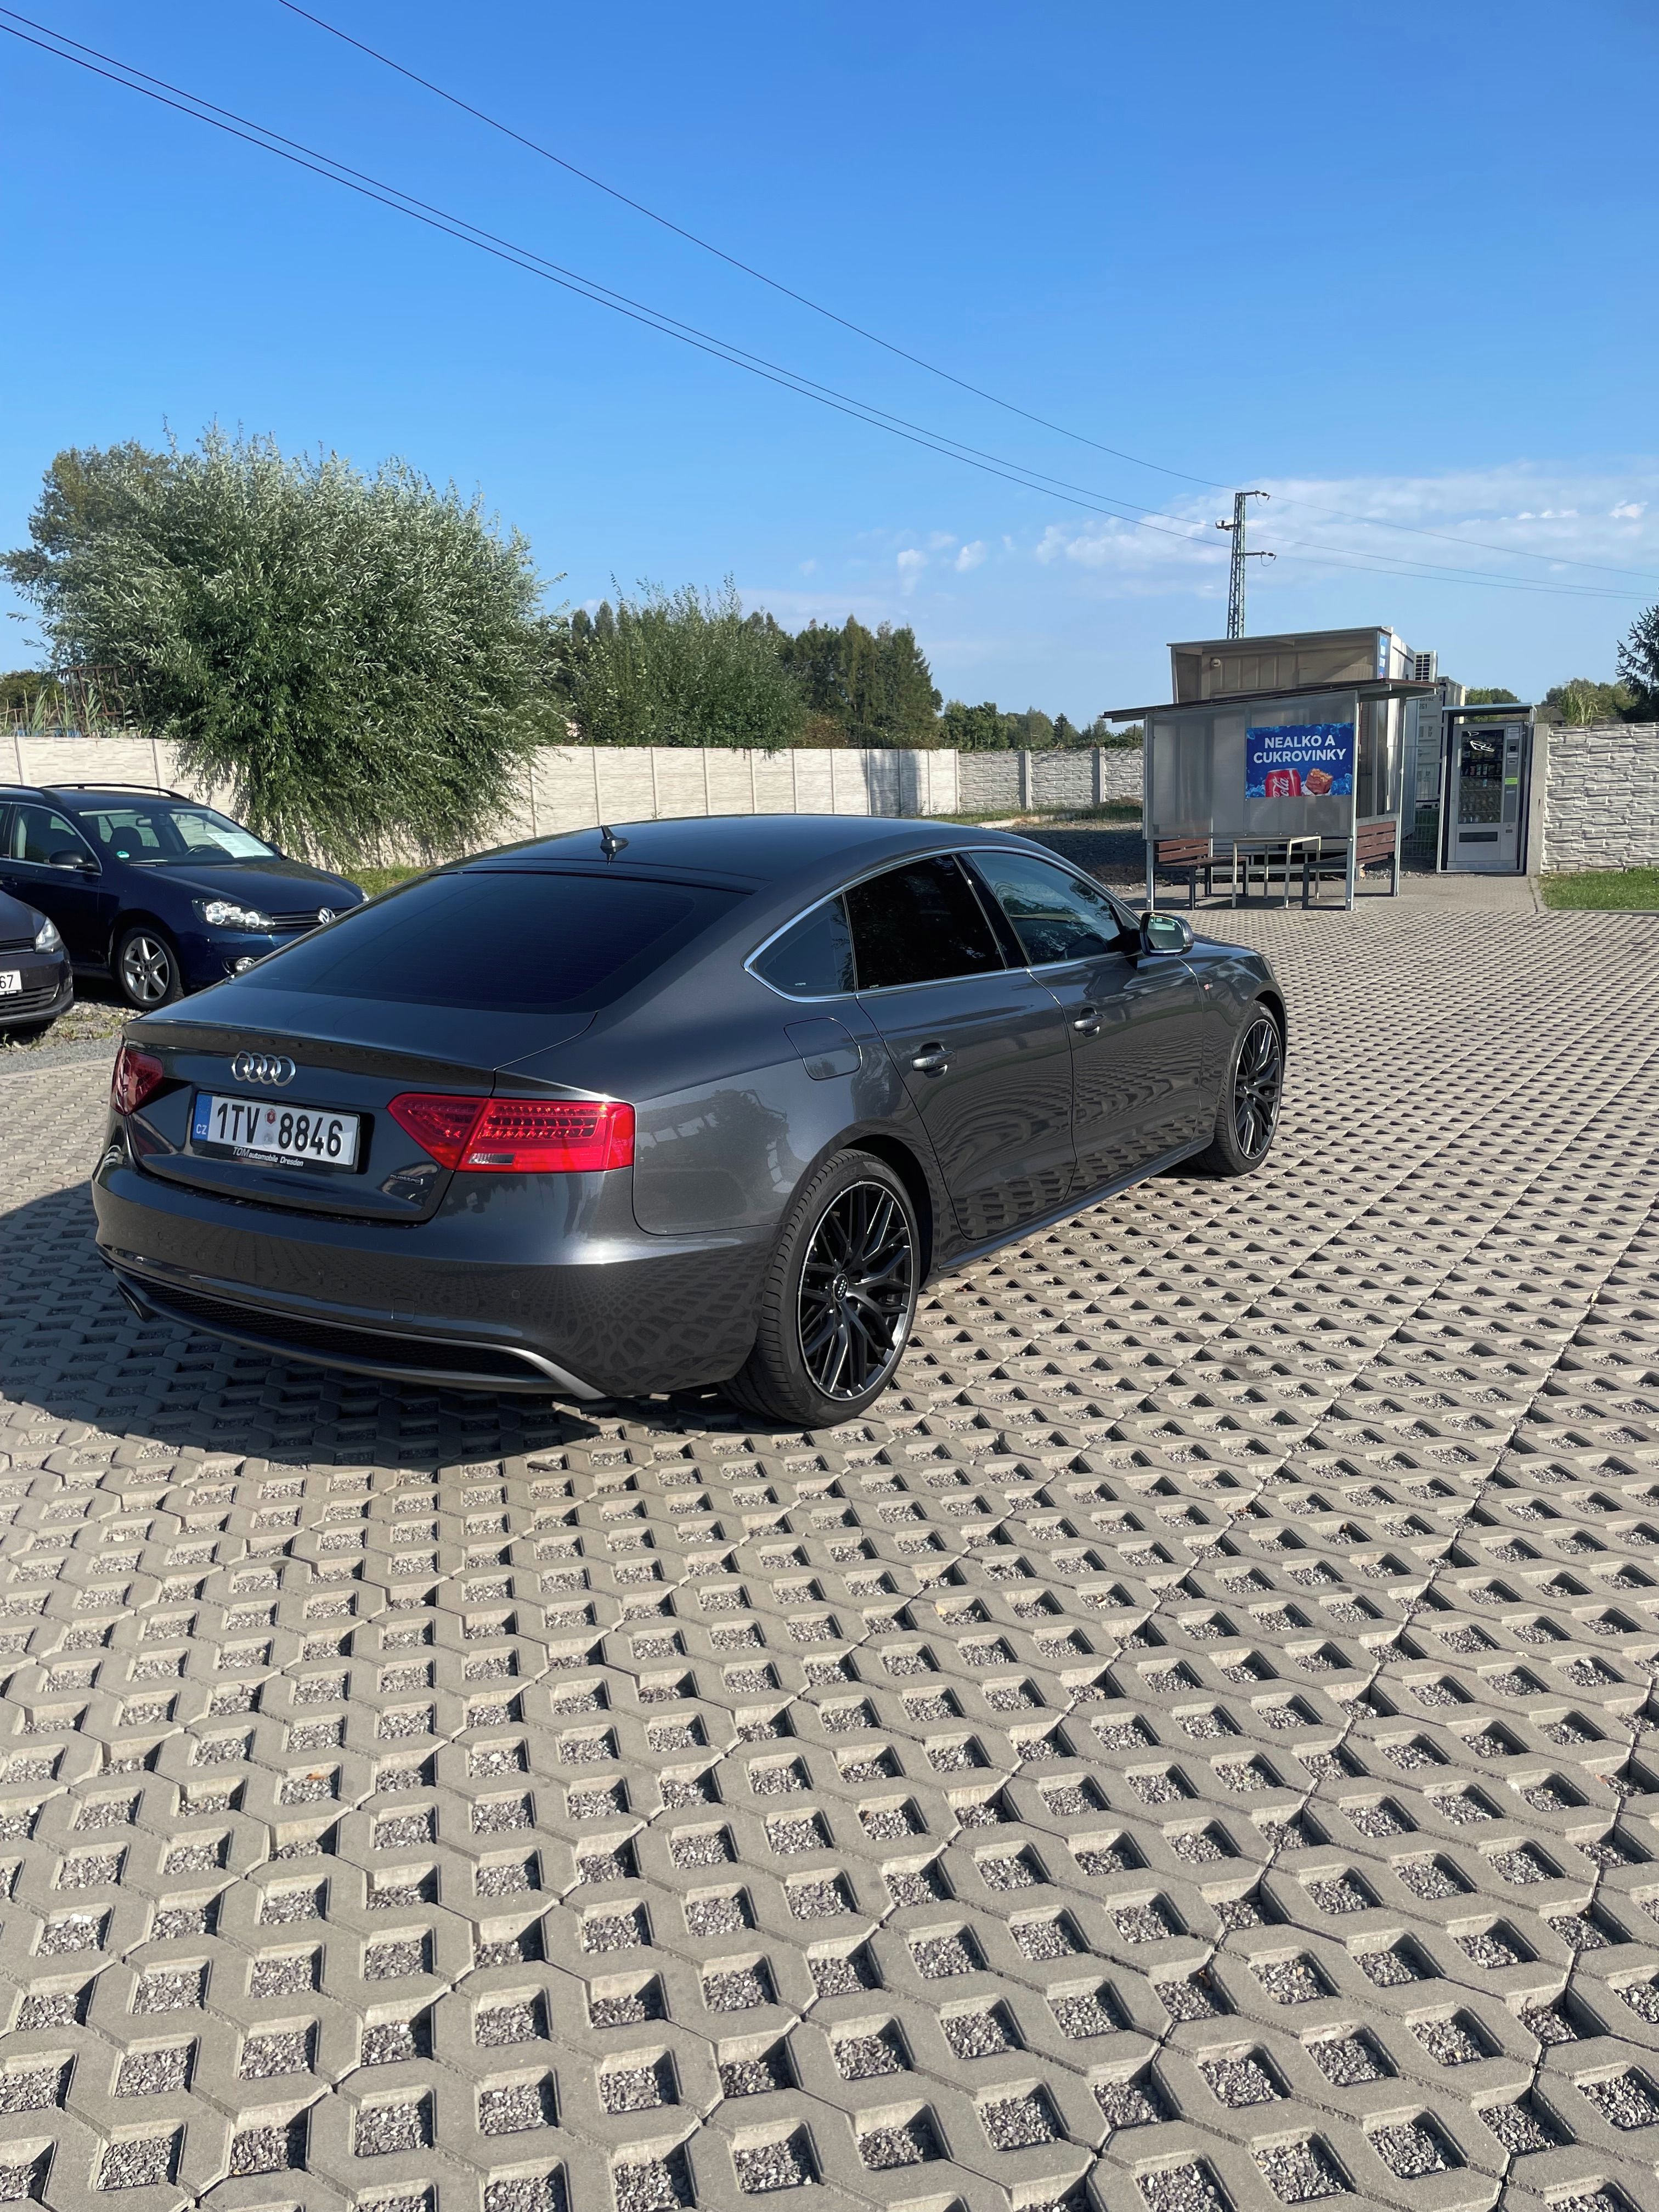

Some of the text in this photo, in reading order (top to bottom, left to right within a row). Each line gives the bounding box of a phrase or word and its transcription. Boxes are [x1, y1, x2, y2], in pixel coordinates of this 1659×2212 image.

[1265, 735, 1335, 748] NEALKO A
[1254, 748, 1346, 763] CUKROVINKY
[196, 1124, 207, 1135] CZ
[217, 1103, 343, 1156] 1TV 8846
[280, 1156, 303, 1166] Dresden
